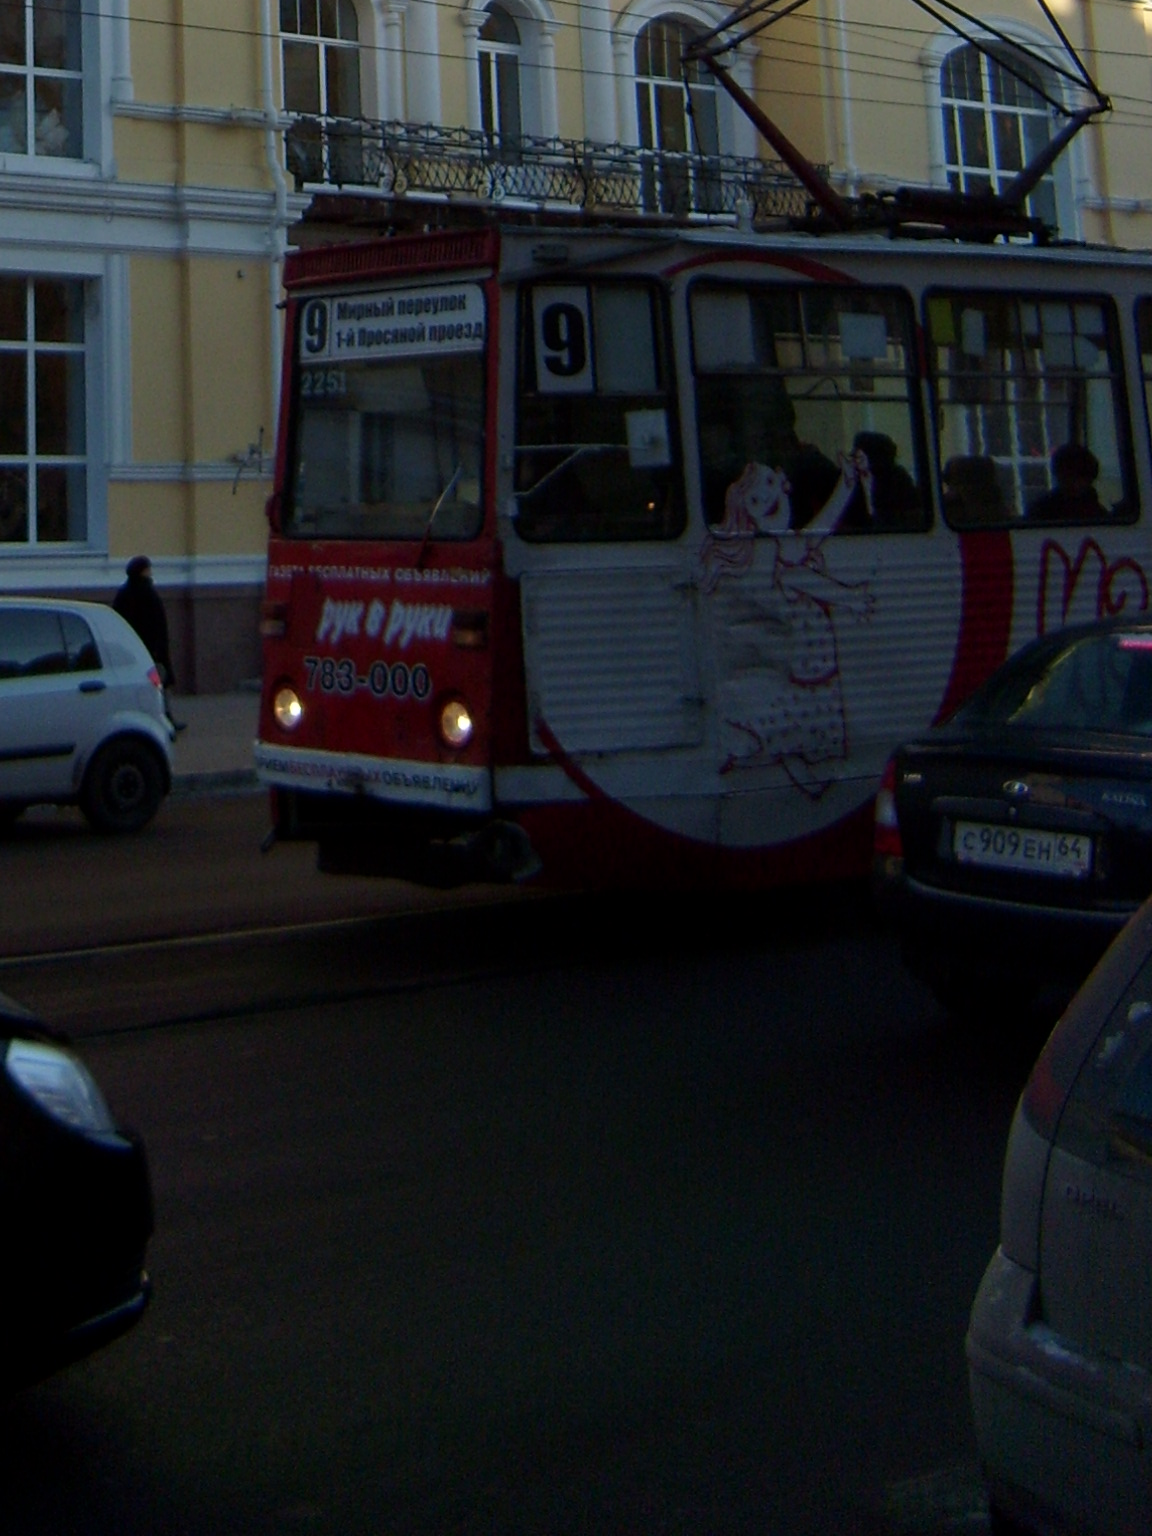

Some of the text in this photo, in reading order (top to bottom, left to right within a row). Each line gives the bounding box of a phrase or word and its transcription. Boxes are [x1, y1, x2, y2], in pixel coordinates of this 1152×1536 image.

[305, 298, 328, 354] 9
[337, 292, 467, 321] Мирный переулок
[336, 321, 483, 349] 1-й Просяной проезд
[542, 301, 587, 378] 9
[315, 596, 365, 646] рук
[382, 596, 454, 650] руки
[304, 655, 432, 701] 783-000
